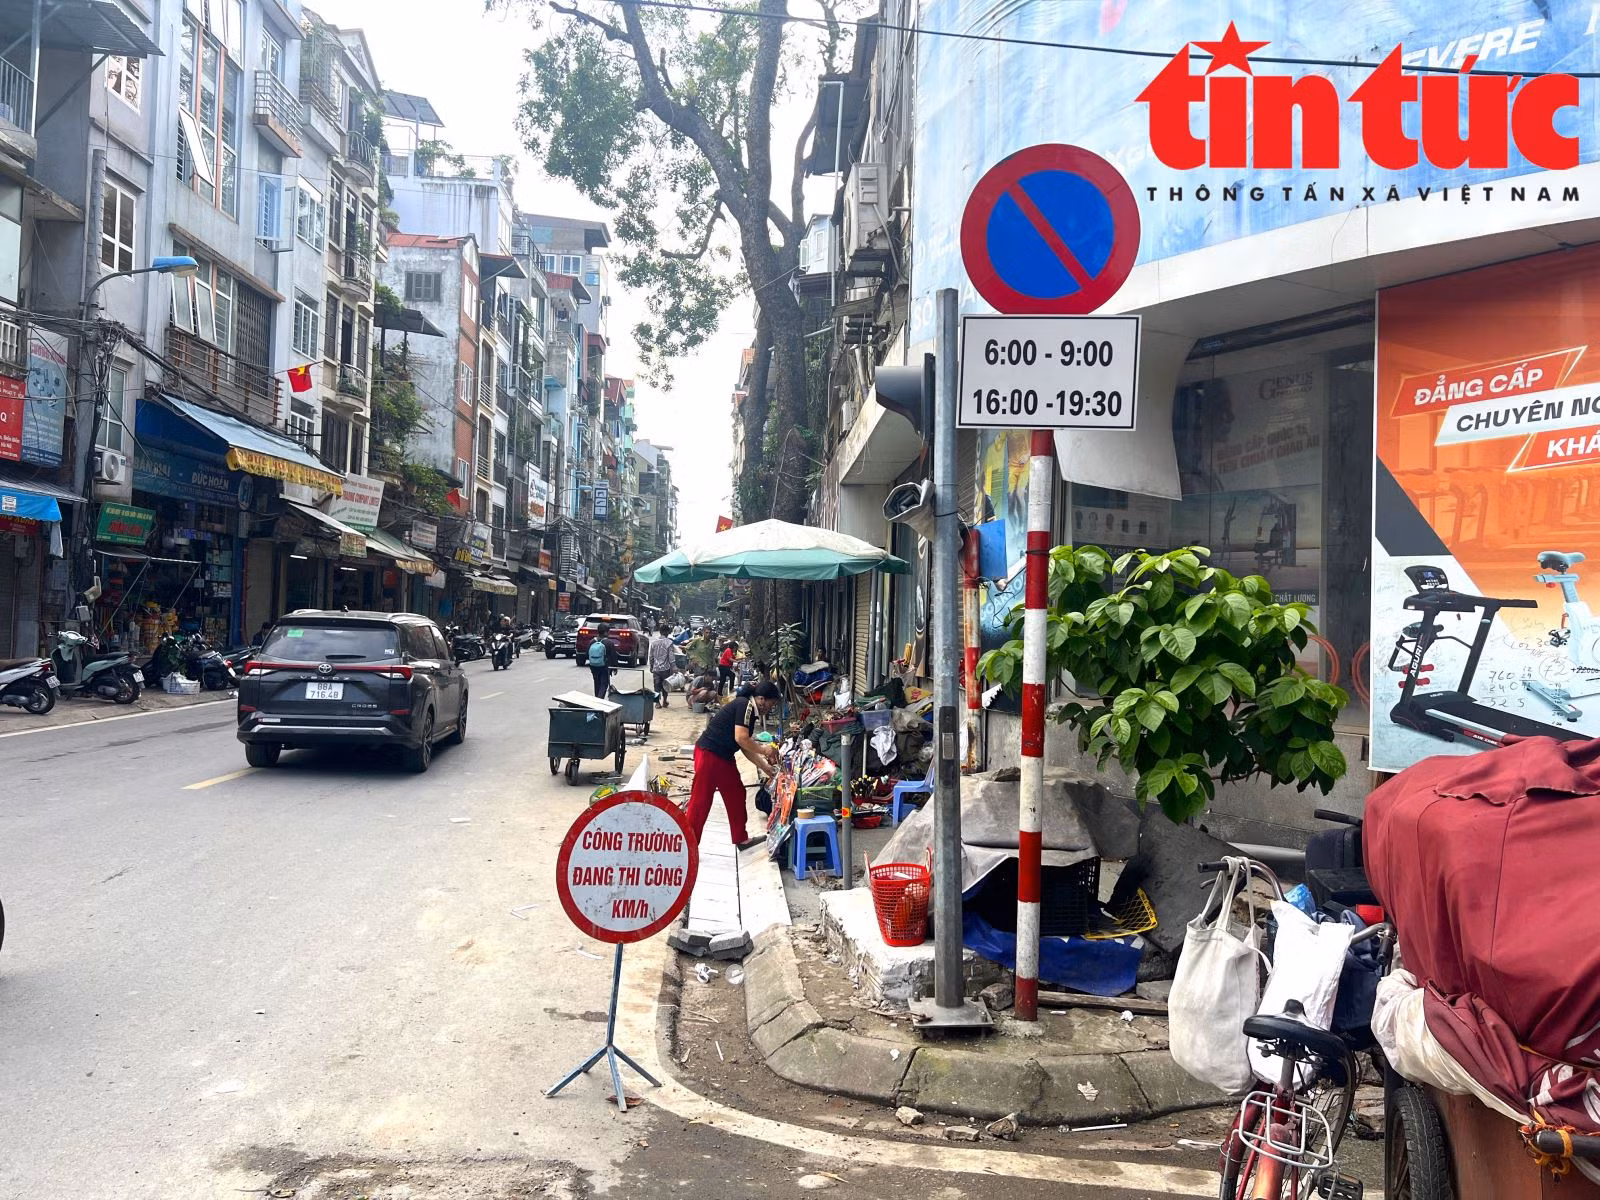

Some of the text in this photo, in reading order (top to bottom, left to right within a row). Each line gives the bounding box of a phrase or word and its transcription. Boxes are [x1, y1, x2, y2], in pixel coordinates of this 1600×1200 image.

[984, 339, 1037, 366] 6:00
[1060, 339, 1113, 367] 9:00
[1414, 362, 1544, 406] ĐẲNG CẤP
[972, 388, 1038, 417] 16:00
[1456, 400, 1565, 432] CHUYÊN
[1409, 644, 1424, 678] AGURI
[310, 690, 339, 699] 716.48
[317, 682, 333, 691] 88A
[582, 827, 683, 853] CÔNG TRƯỜNG
[572, 864, 683, 887] ĐANG THI CÔNG
[611, 899, 649, 919] KM/h
